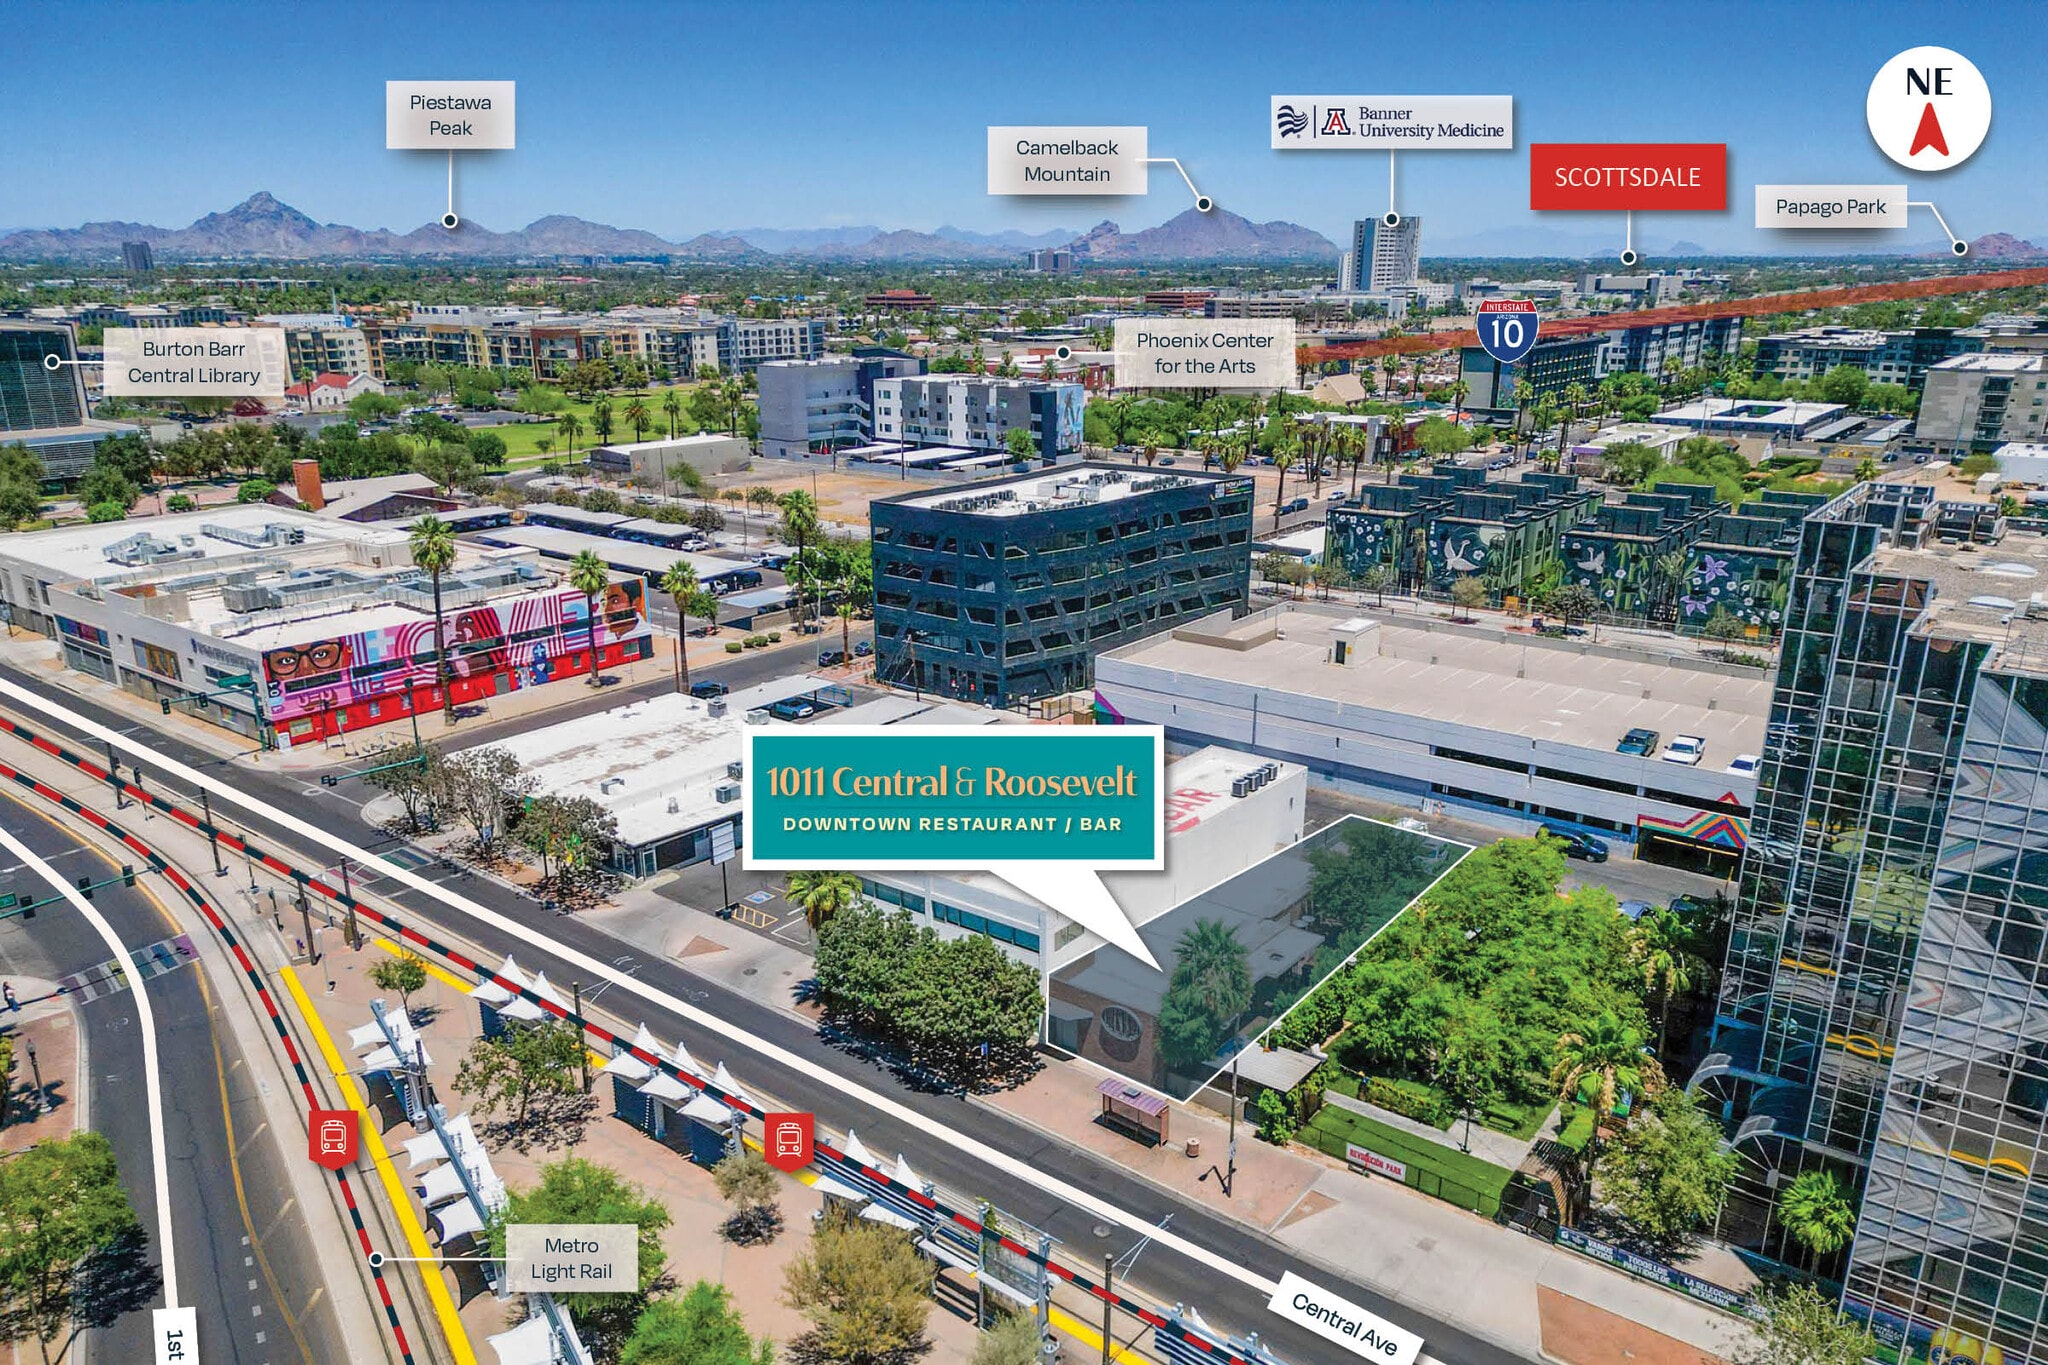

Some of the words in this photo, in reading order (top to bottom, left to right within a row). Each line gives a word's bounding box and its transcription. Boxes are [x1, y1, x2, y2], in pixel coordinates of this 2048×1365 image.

[1628, 1255, 1653, 1271] TODOS
[1653, 1264, 1669, 1277] LOS
[1684, 1277, 1695, 1287] LA
